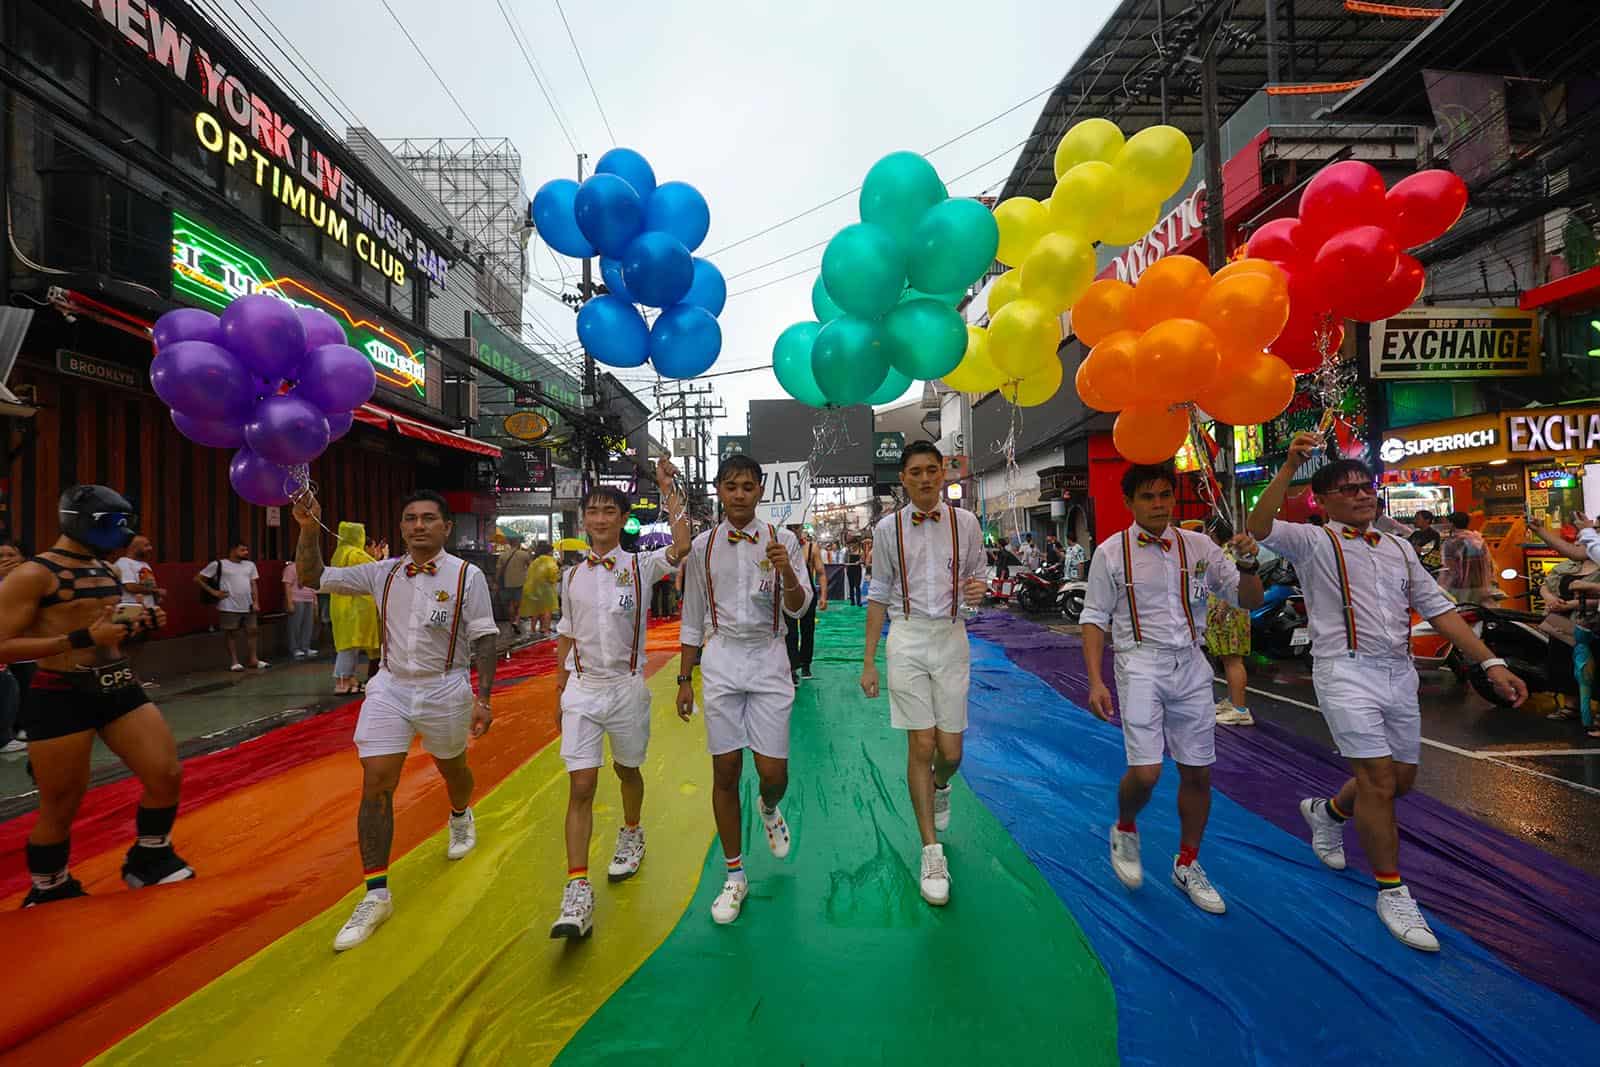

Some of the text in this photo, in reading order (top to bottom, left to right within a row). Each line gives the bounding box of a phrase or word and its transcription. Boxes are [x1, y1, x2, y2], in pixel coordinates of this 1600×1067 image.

[198, 46, 295, 169] YORK
[356, 185, 415, 262] MUSIC
[415, 238, 449, 289] BAR
[194, 112, 348, 248] OPTIMUM
[355, 232, 406, 287] CLUB
[1428, 319, 1458, 329] BEST
[1381, 329, 1531, 361] EXCHANGE
[70, 359, 134, 384] BROOKLYN
[1415, 362, 1495, 370] SERVICE
[1404, 429, 1495, 456] SUPERRICH
[1509, 413, 1600, 452] EXCHA
[876, 448, 903, 459] Chang
[759, 470, 802, 503] ZAG
[837, 475, 870, 484] STREET
[430, 610, 447, 623] ZAG
[100, 668, 133, 686] CPS
